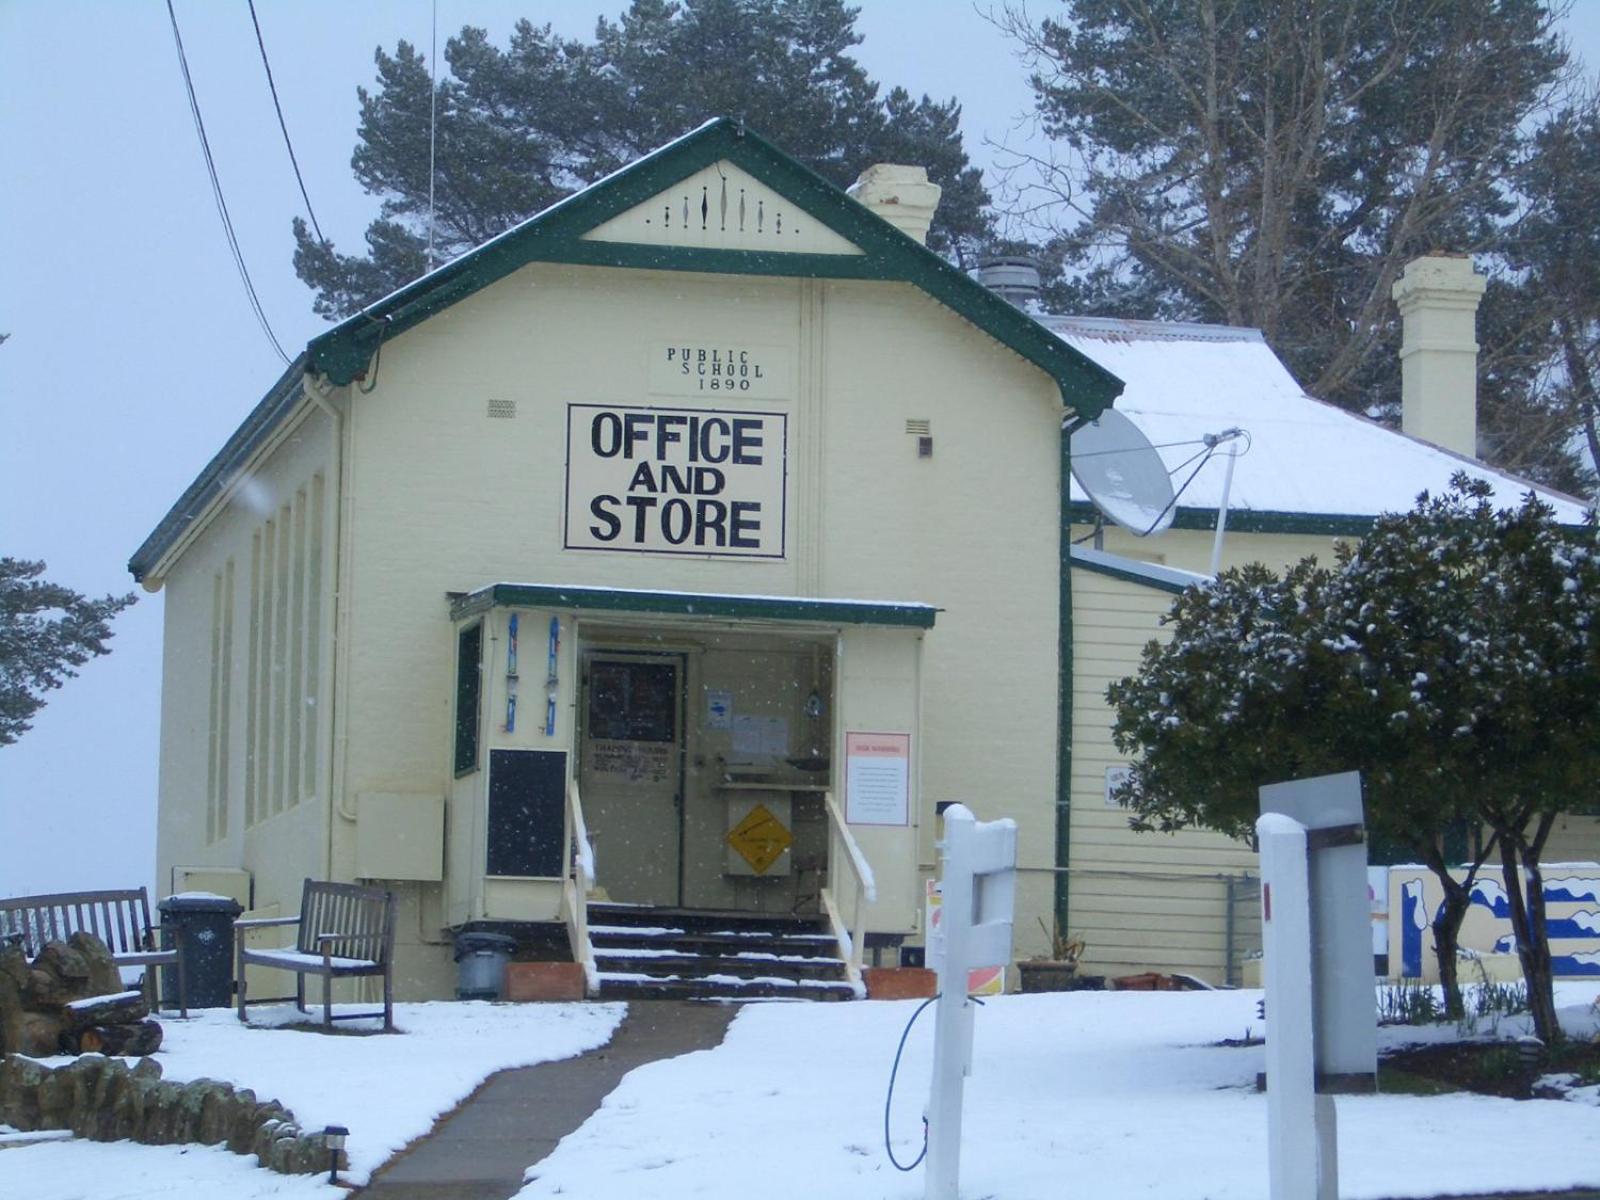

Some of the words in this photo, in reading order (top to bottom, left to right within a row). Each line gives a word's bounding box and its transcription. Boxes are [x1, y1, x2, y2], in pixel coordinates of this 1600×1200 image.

[667, 348, 748, 364] PUBLIC
[681, 362, 763, 378] SCHOOL
[699, 378, 750, 391] 1890
[591, 412, 763, 465] OFFICE
[628, 461, 726, 496] AND
[589, 494, 761, 549] STORE
